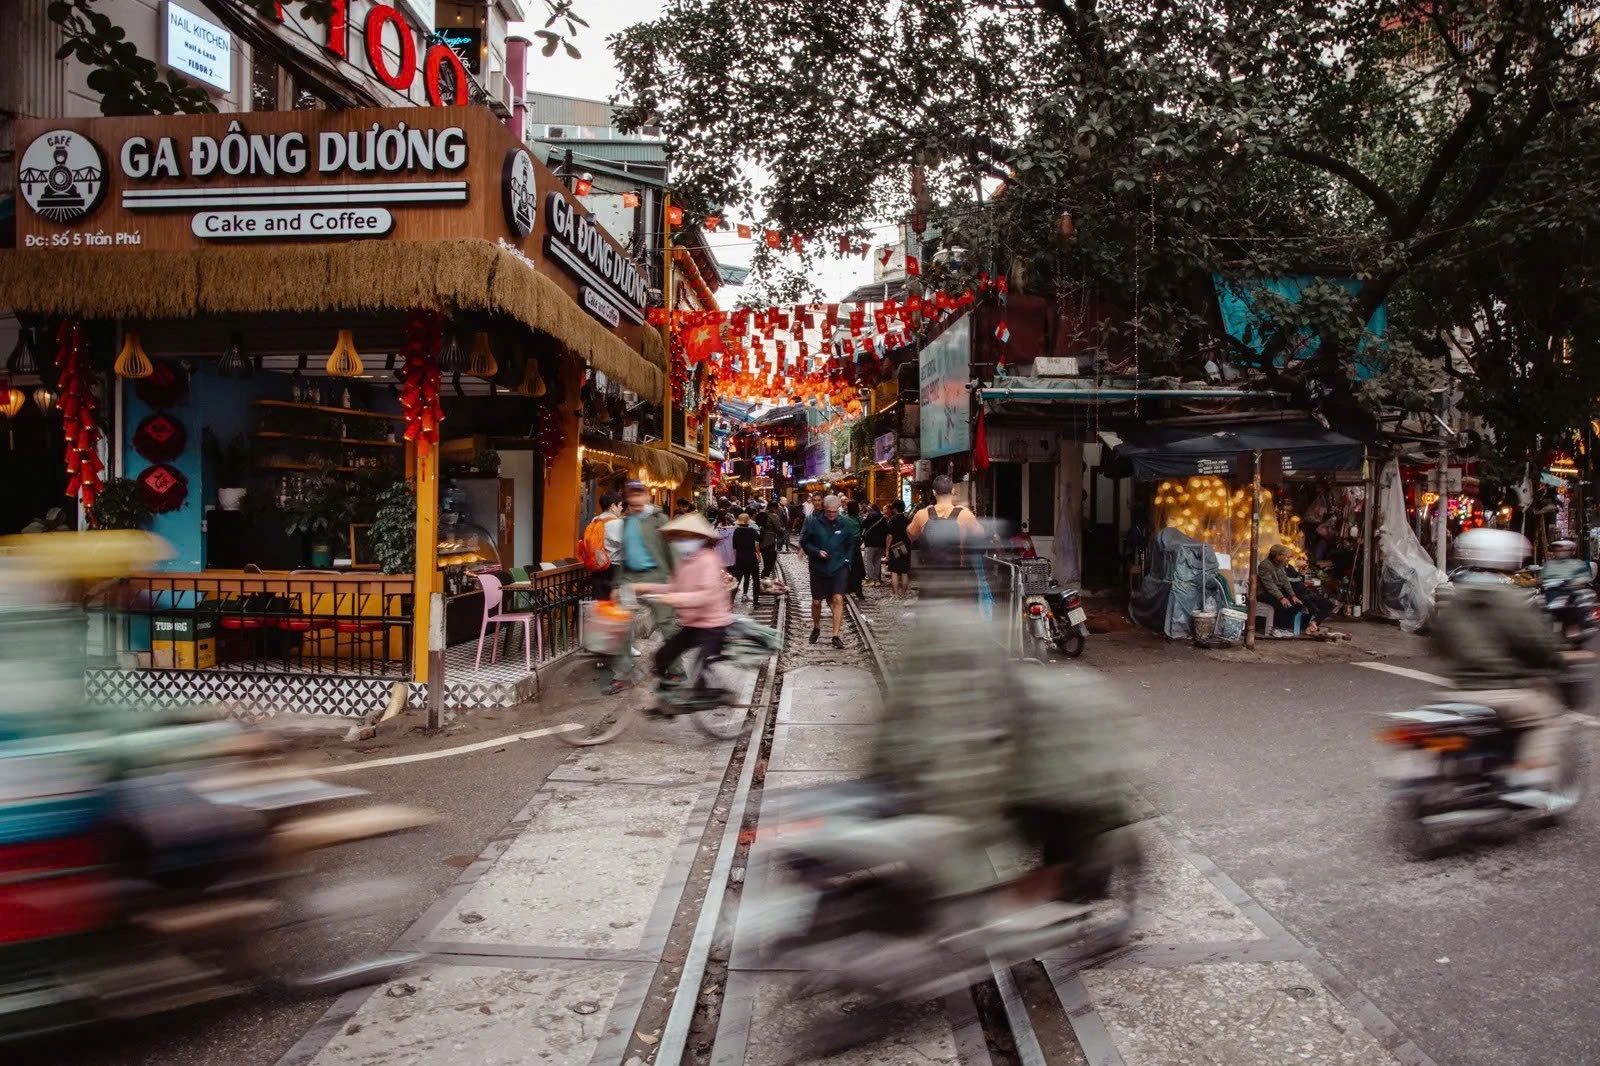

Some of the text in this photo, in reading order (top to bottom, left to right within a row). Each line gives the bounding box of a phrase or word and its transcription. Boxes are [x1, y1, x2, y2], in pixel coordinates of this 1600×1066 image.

[171, 13, 229, 52] NAIL KITCHEN
[184, 41, 197, 53] Nail
[203, 49, 217, 61] Lash
[188, 59, 213, 77] FLOOR 2
[47, 135, 72, 147] CAFÉ
[120, 120, 467, 179] GA ĐÔNG DƯƠNG
[205, 211, 378, 233] Cake and Coffee
[553, 192, 575, 245] GA
[25, 228, 140, 248] Đc: Số 5 Trần Phú
[587, 291, 618, 322] Cake and Coffee
[155, 621, 188, 632] TUBORG
